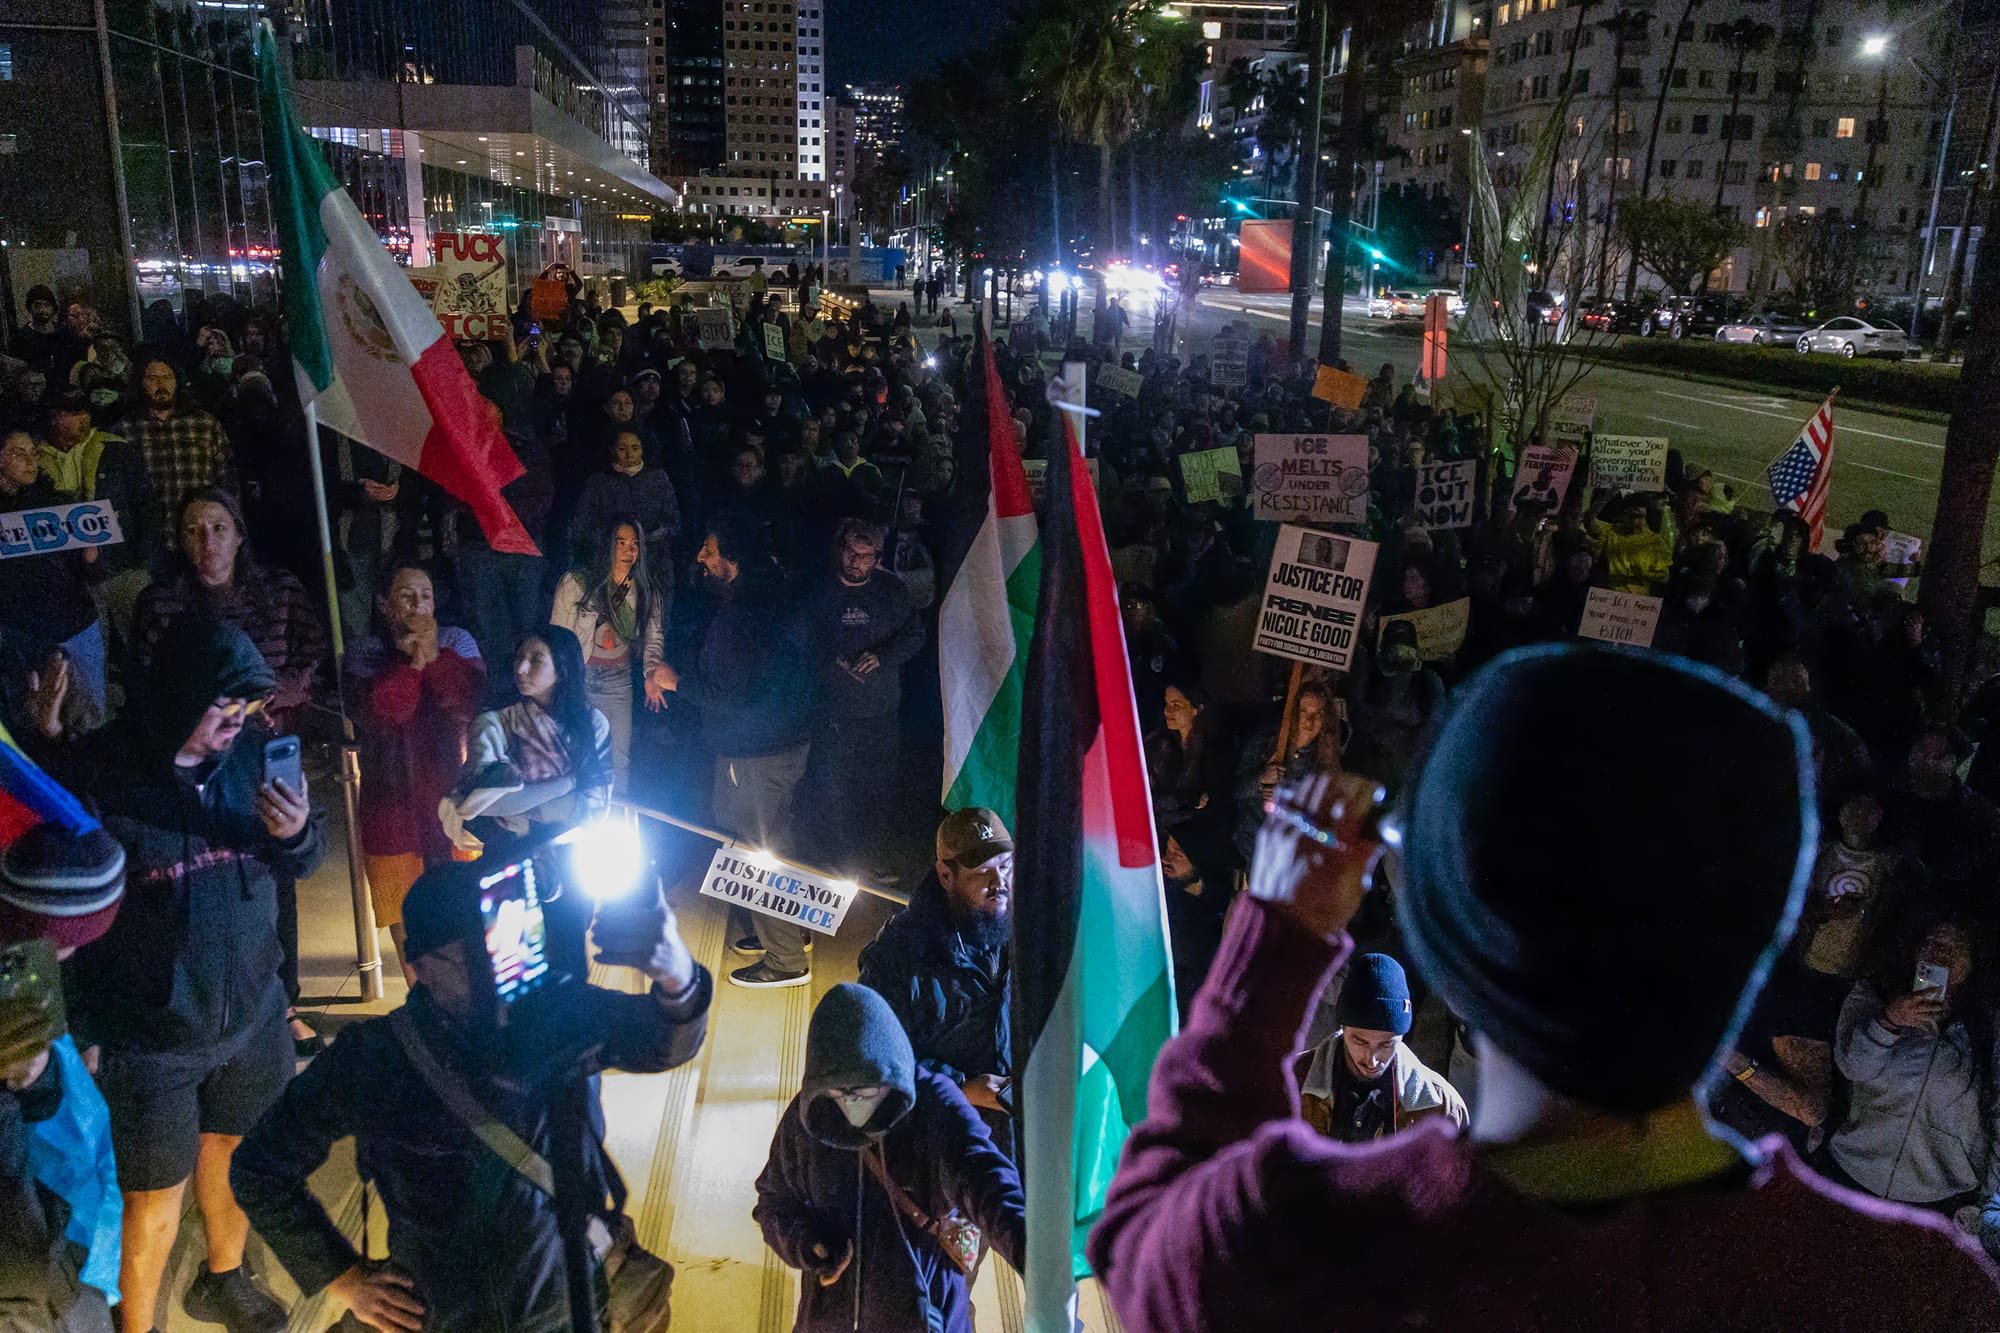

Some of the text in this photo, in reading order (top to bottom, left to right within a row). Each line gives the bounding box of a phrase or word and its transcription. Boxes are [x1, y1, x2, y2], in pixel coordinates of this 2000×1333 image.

[435, 232, 504, 262] FUCK
[438, 314, 509, 341] ICE
[766, 335, 783, 348] ICE
[1294, 438, 1328, 454] ICE
[1592, 446, 1651, 458] Allow your
[1594, 437, 1664, 450] Whatever You
[1282, 459, 1343, 475] MELTS
[1421, 463, 1464, 485] ICE
[1650, 459, 1662, 467] to
[1288, 479, 1330, 491] UNDER
[1420, 481, 1469, 505] OUT
[1261, 492, 1354, 515] RESISTANCE
[1419, 502, 1470, 526] NOW
[82, 516, 110, 532] OF
[1273, 562, 1364, 600] JUSTICE FOR
[1267, 594, 1356, 627] RENEE
[1261, 611, 1353, 650] NICOLE GOOD
[1600, 625, 1634, 641] BITCH
[970, 822, 995, 840] LA
[716, 856, 846, 910] JUSTICE-NOT
[712, 876, 836, 929] COWARDICE
